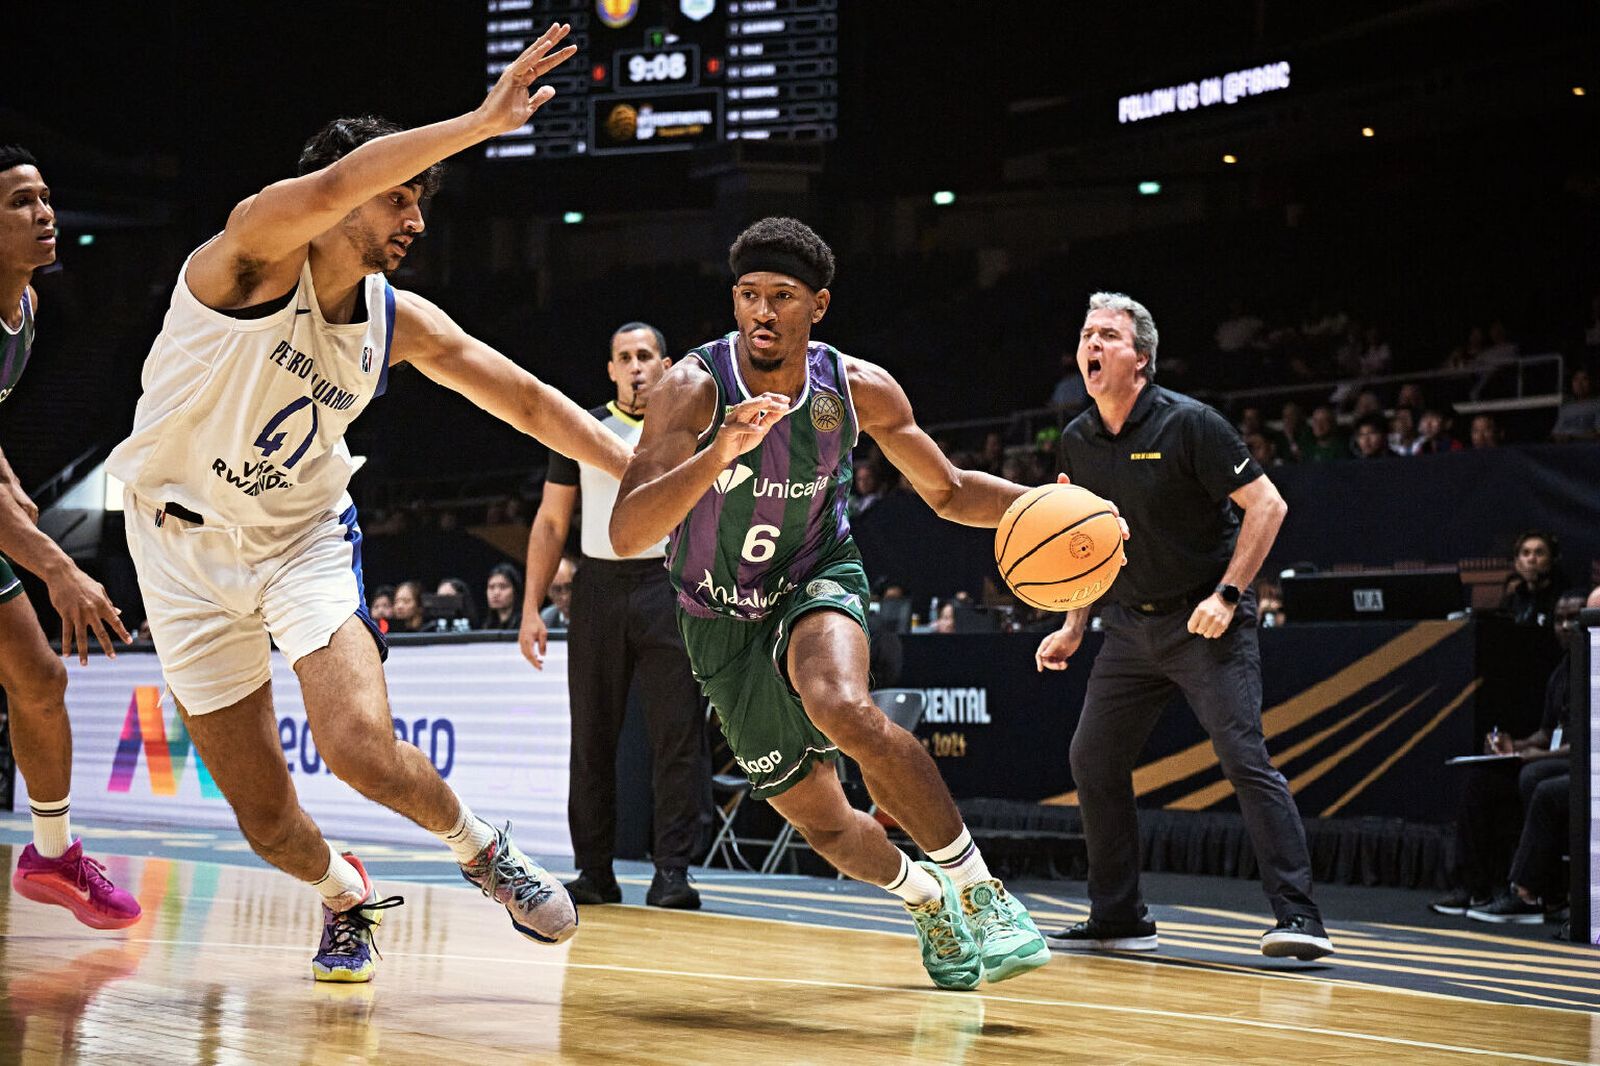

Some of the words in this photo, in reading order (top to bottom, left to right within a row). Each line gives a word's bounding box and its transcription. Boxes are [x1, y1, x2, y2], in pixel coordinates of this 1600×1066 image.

[1118, 87, 1176, 123] FOLLOW
[1176, 82, 1199, 111] US
[1199, 76, 1222, 106] ON
[752, 476, 830, 499] Unicaja
[741, 524, 781, 563] 6
